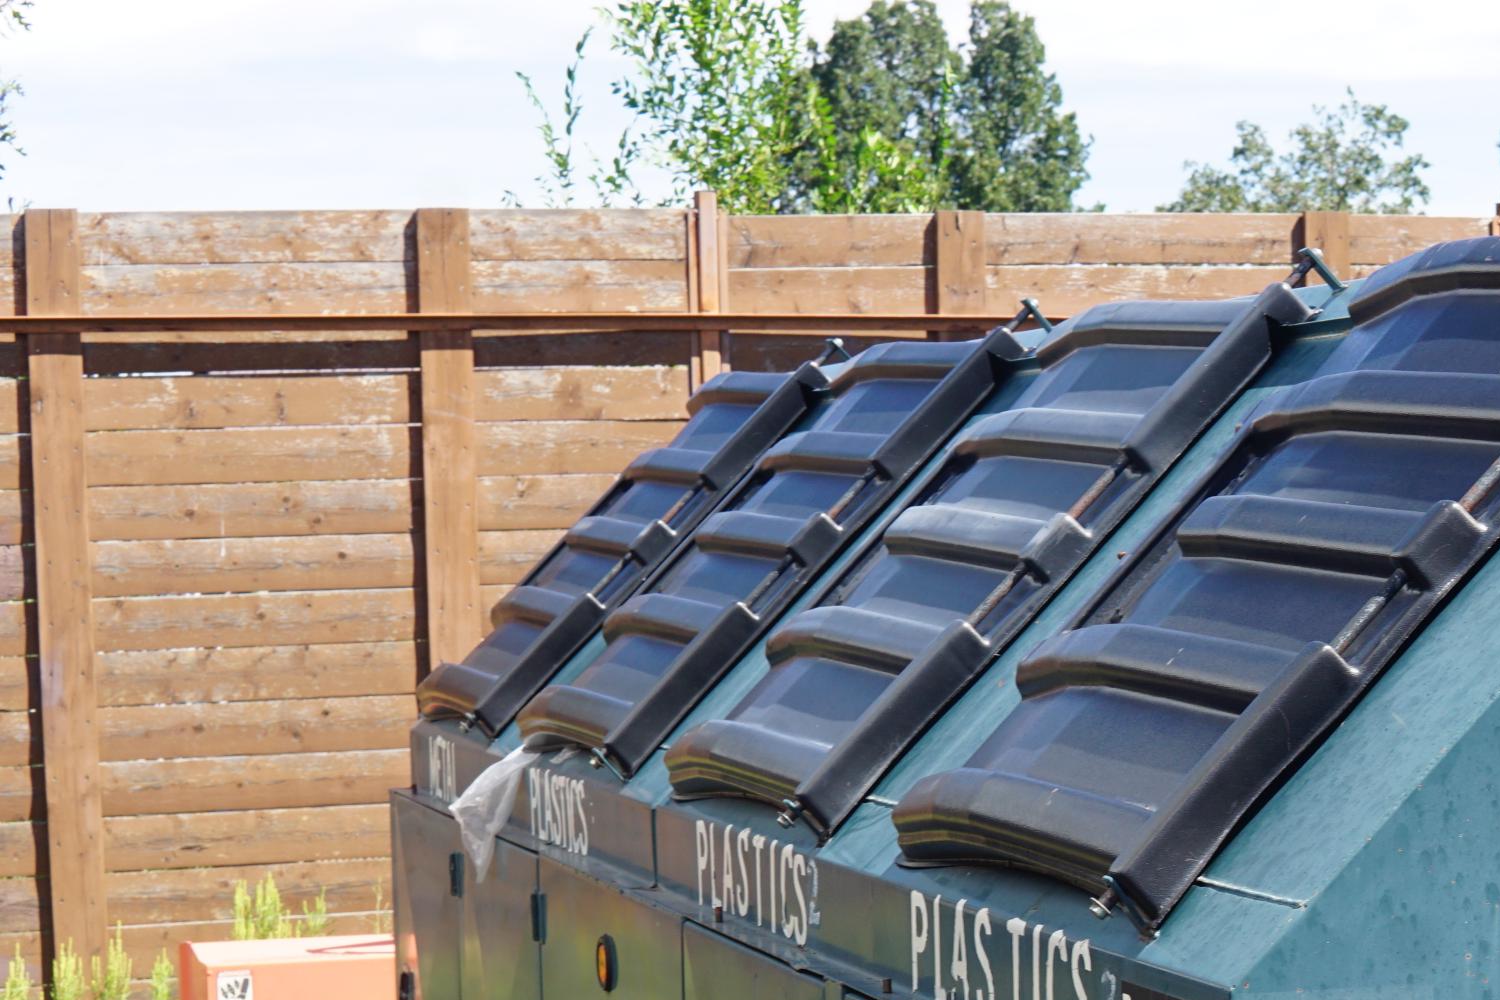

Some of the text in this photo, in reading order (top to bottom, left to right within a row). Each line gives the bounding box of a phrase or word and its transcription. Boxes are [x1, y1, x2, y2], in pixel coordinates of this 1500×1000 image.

[529, 767, 589, 856] PLASTICS
[696, 820, 820, 946] PLASTICS 2
